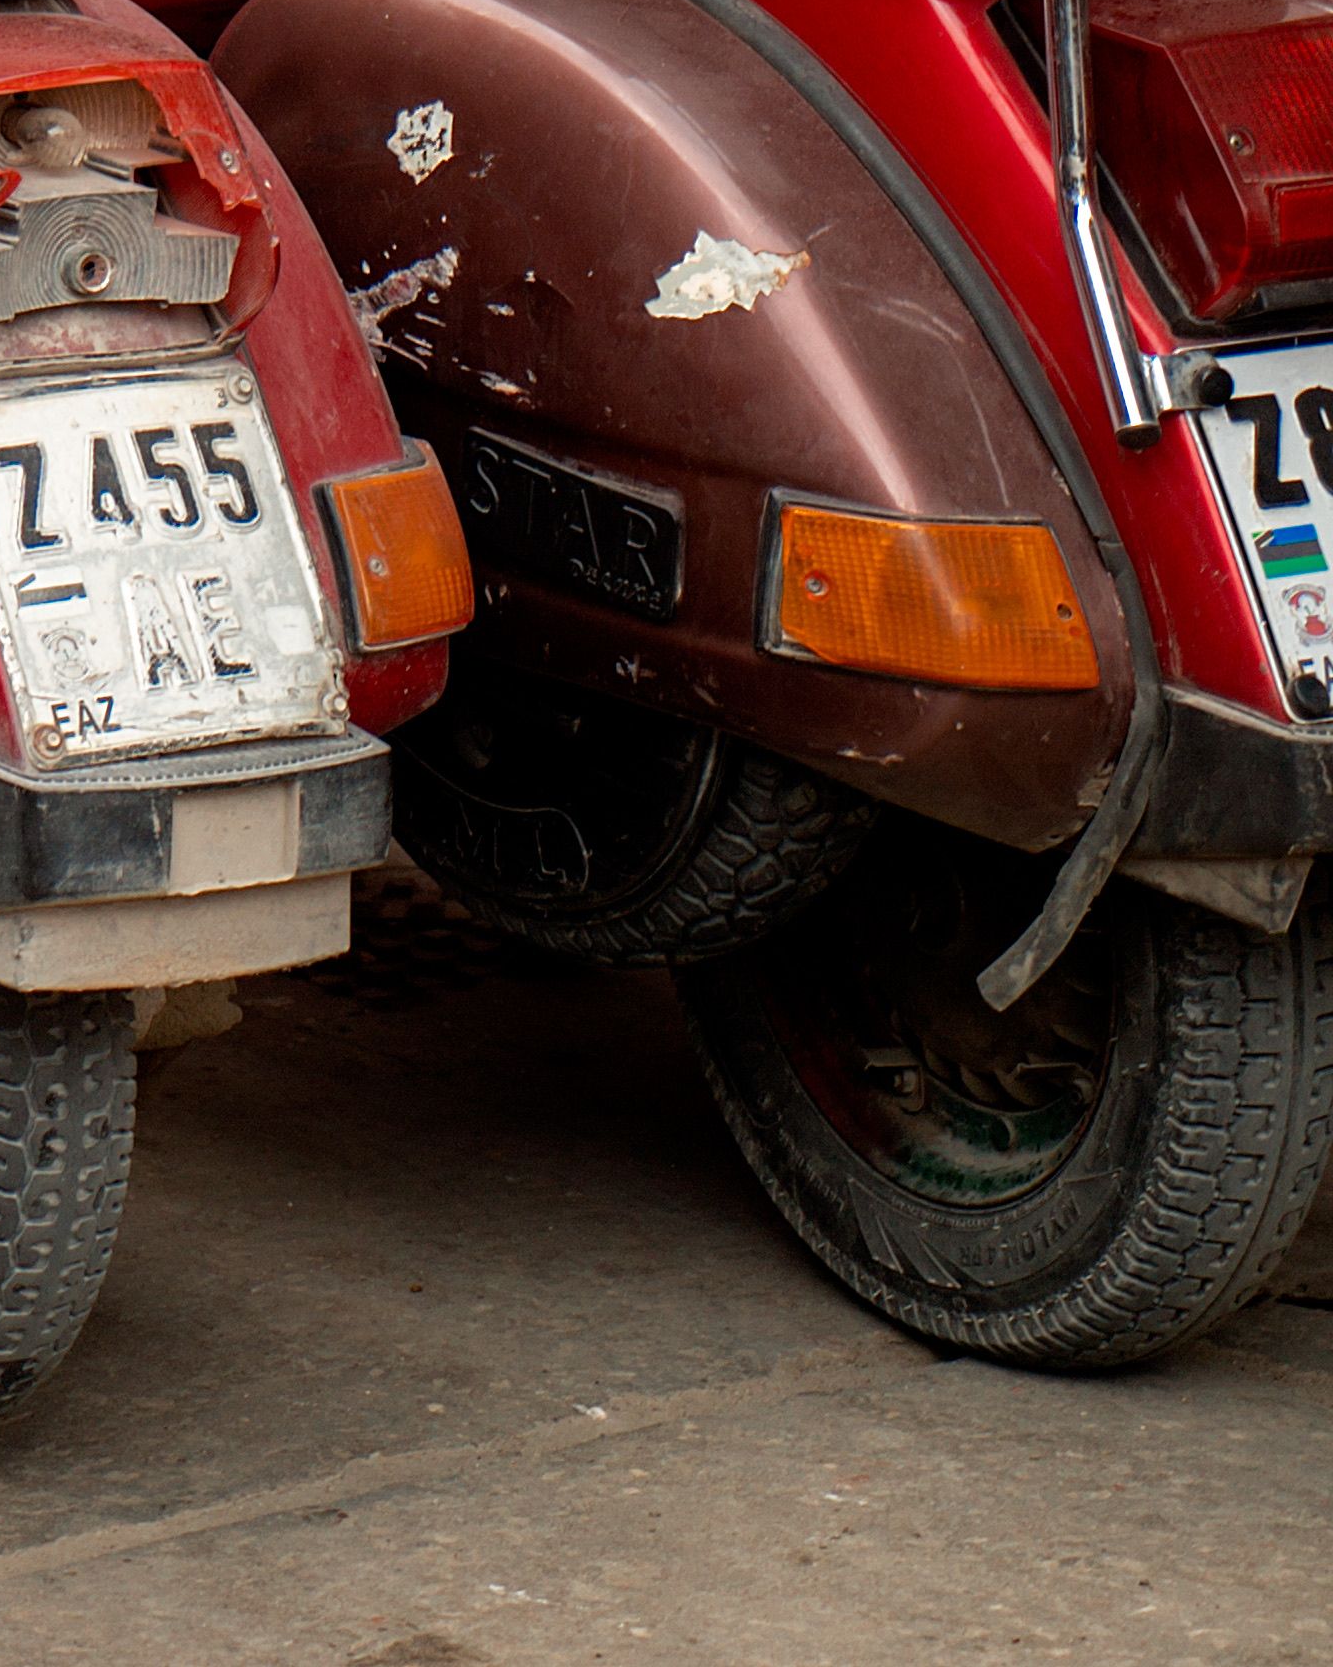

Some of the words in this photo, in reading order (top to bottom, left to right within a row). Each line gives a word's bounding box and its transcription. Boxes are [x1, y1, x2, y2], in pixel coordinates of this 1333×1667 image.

[469, 446, 658, 586] STAR
[131, 573, 257, 689] AE
[50, 694, 123, 741] EAZ
